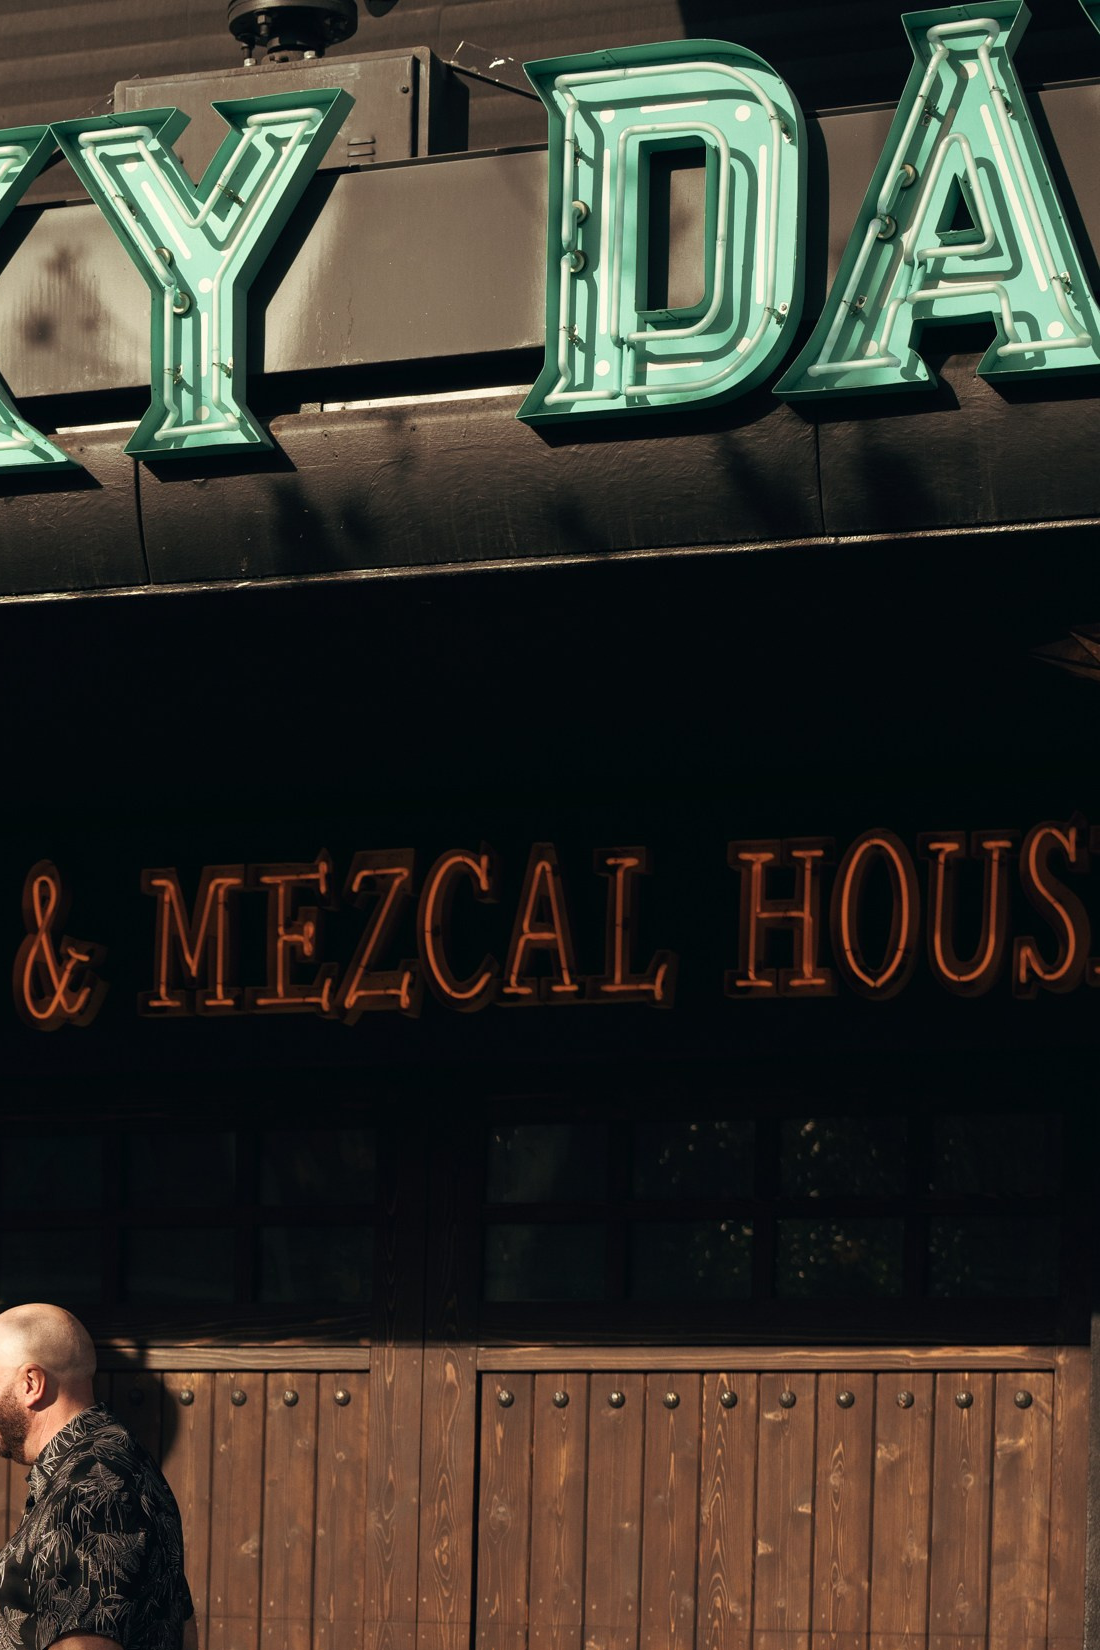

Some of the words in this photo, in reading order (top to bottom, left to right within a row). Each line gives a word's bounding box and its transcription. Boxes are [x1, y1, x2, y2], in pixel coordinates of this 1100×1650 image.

[515, 0, 1100, 424] DA
[12, 858, 108, 1031] &
[137, 841, 679, 1026] MEZCAL
[724, 810, 1100, 1000] HOUS
